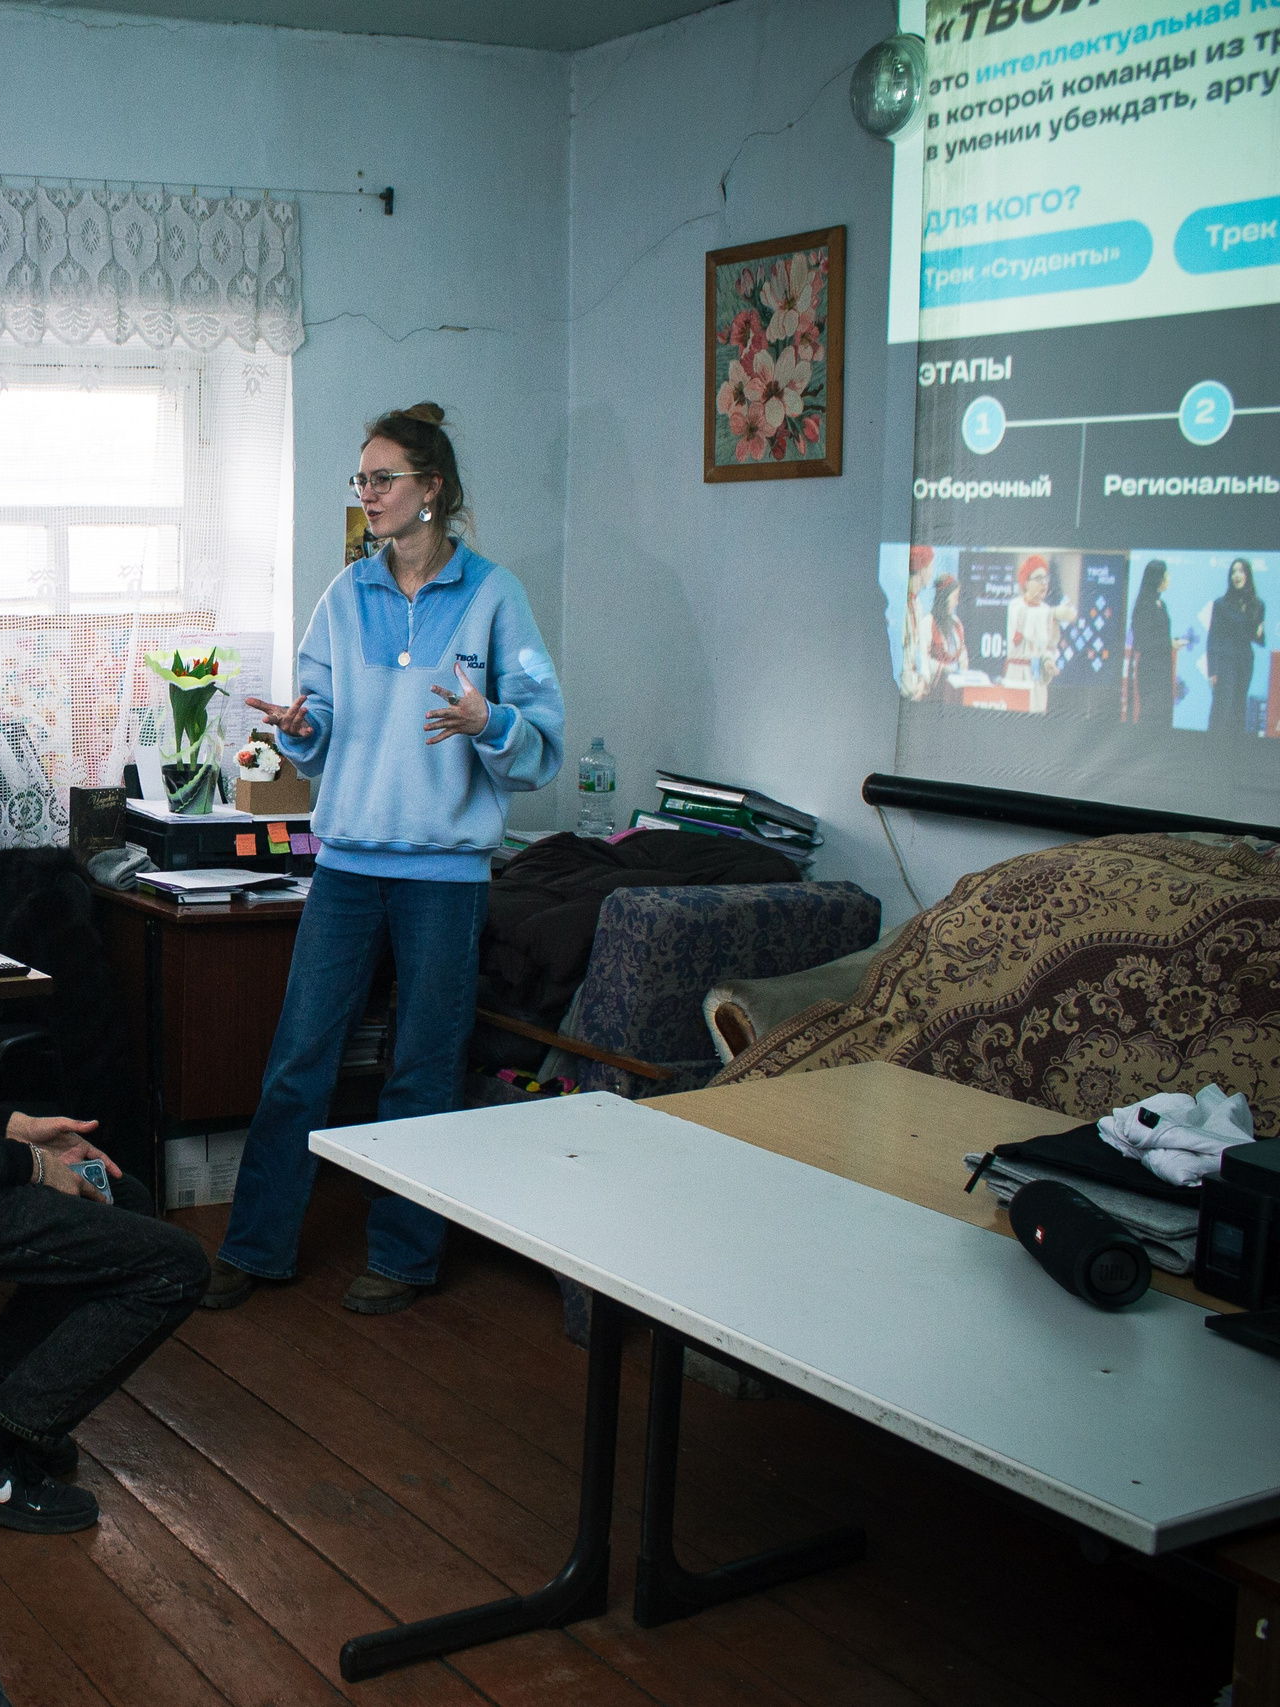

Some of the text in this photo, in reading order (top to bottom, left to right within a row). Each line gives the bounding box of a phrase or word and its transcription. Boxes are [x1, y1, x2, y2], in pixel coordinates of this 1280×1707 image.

[929, 72, 969, 96] это
[976, 0, 1241, 84] интеллектуальная
[927, 113, 940, 130] в
[946, 78, 1054, 127] которой
[1062, 50, 1197, 98] команды
[1206, 37, 1245, 65] из
[926, 145, 939, 162] в
[945, 121, 1041, 164] умении
[1049, 90, 1198, 142] убеждать,
[924, 184, 1081, 240] ДЛЯ КОГО?
[1205, 219, 1278, 252] Трек
[924, 246, 1121, 293] Трек «Студенты»
[918, 355, 1012, 387] ЭТАПЫ
[975, 412, 991, 435] 1
[1194, 398, 1216, 424] 2
[913, 474, 1052, 504] Отборочный
[455, 653, 478, 662] ТВОЙ
